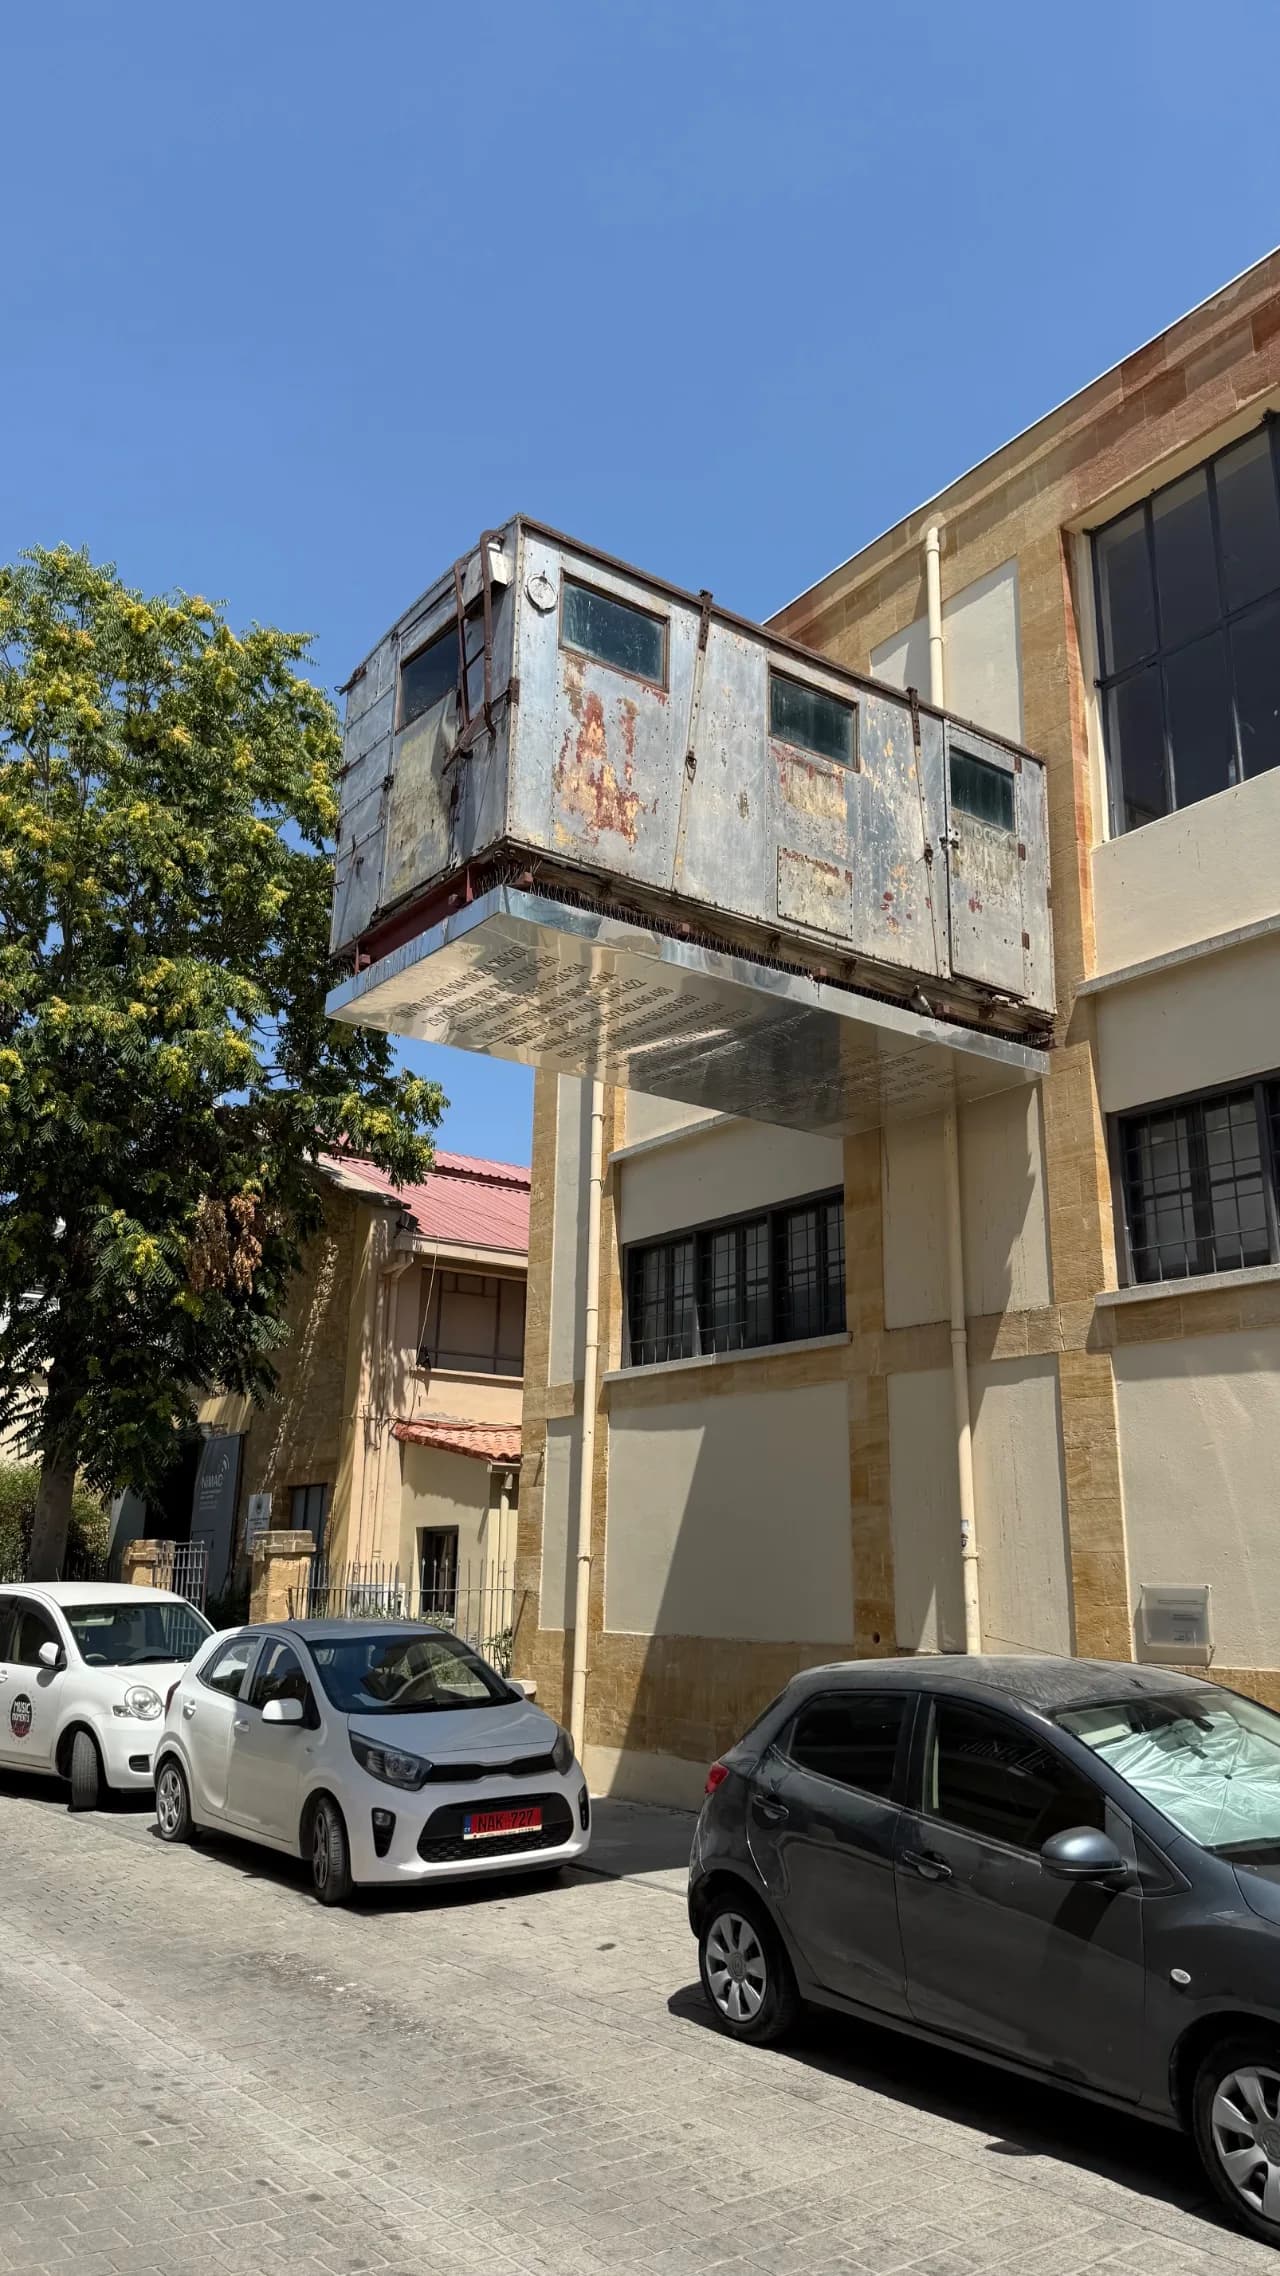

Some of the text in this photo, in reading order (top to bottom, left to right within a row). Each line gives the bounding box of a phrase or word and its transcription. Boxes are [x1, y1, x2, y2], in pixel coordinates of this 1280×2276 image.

[14, 1701, 31, 1713] MUSIC
[478, 1810, 534, 1832] NAK 727
